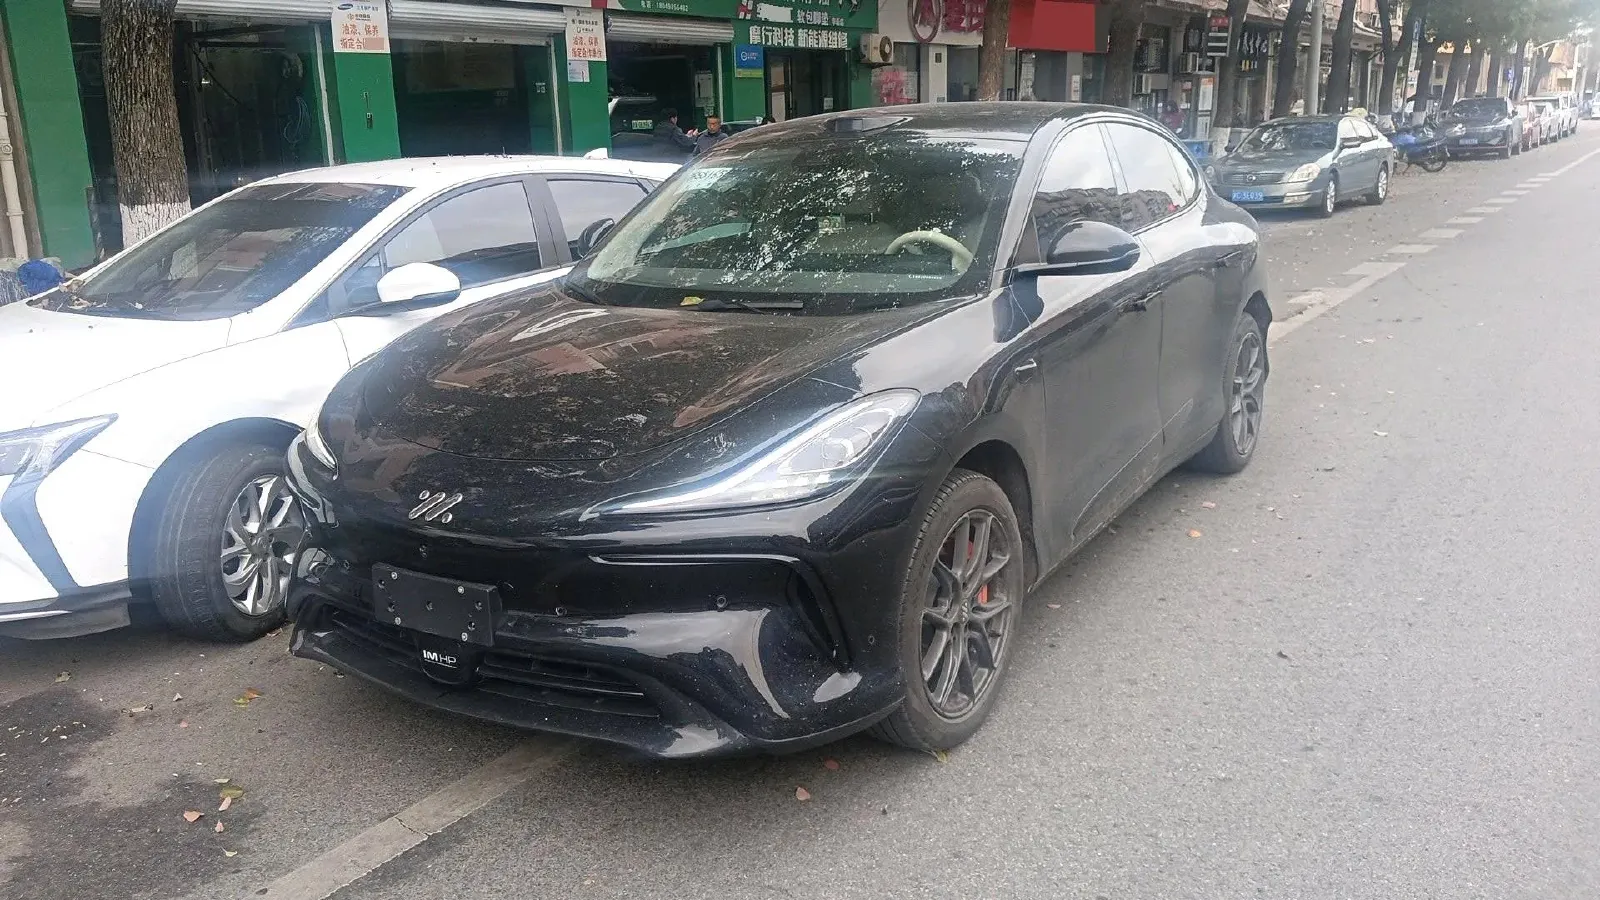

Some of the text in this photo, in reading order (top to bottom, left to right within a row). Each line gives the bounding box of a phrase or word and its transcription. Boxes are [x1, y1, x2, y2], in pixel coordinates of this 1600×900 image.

[798, 28, 848, 49] 新能源维修
[423, 650, 438, 661] IM
